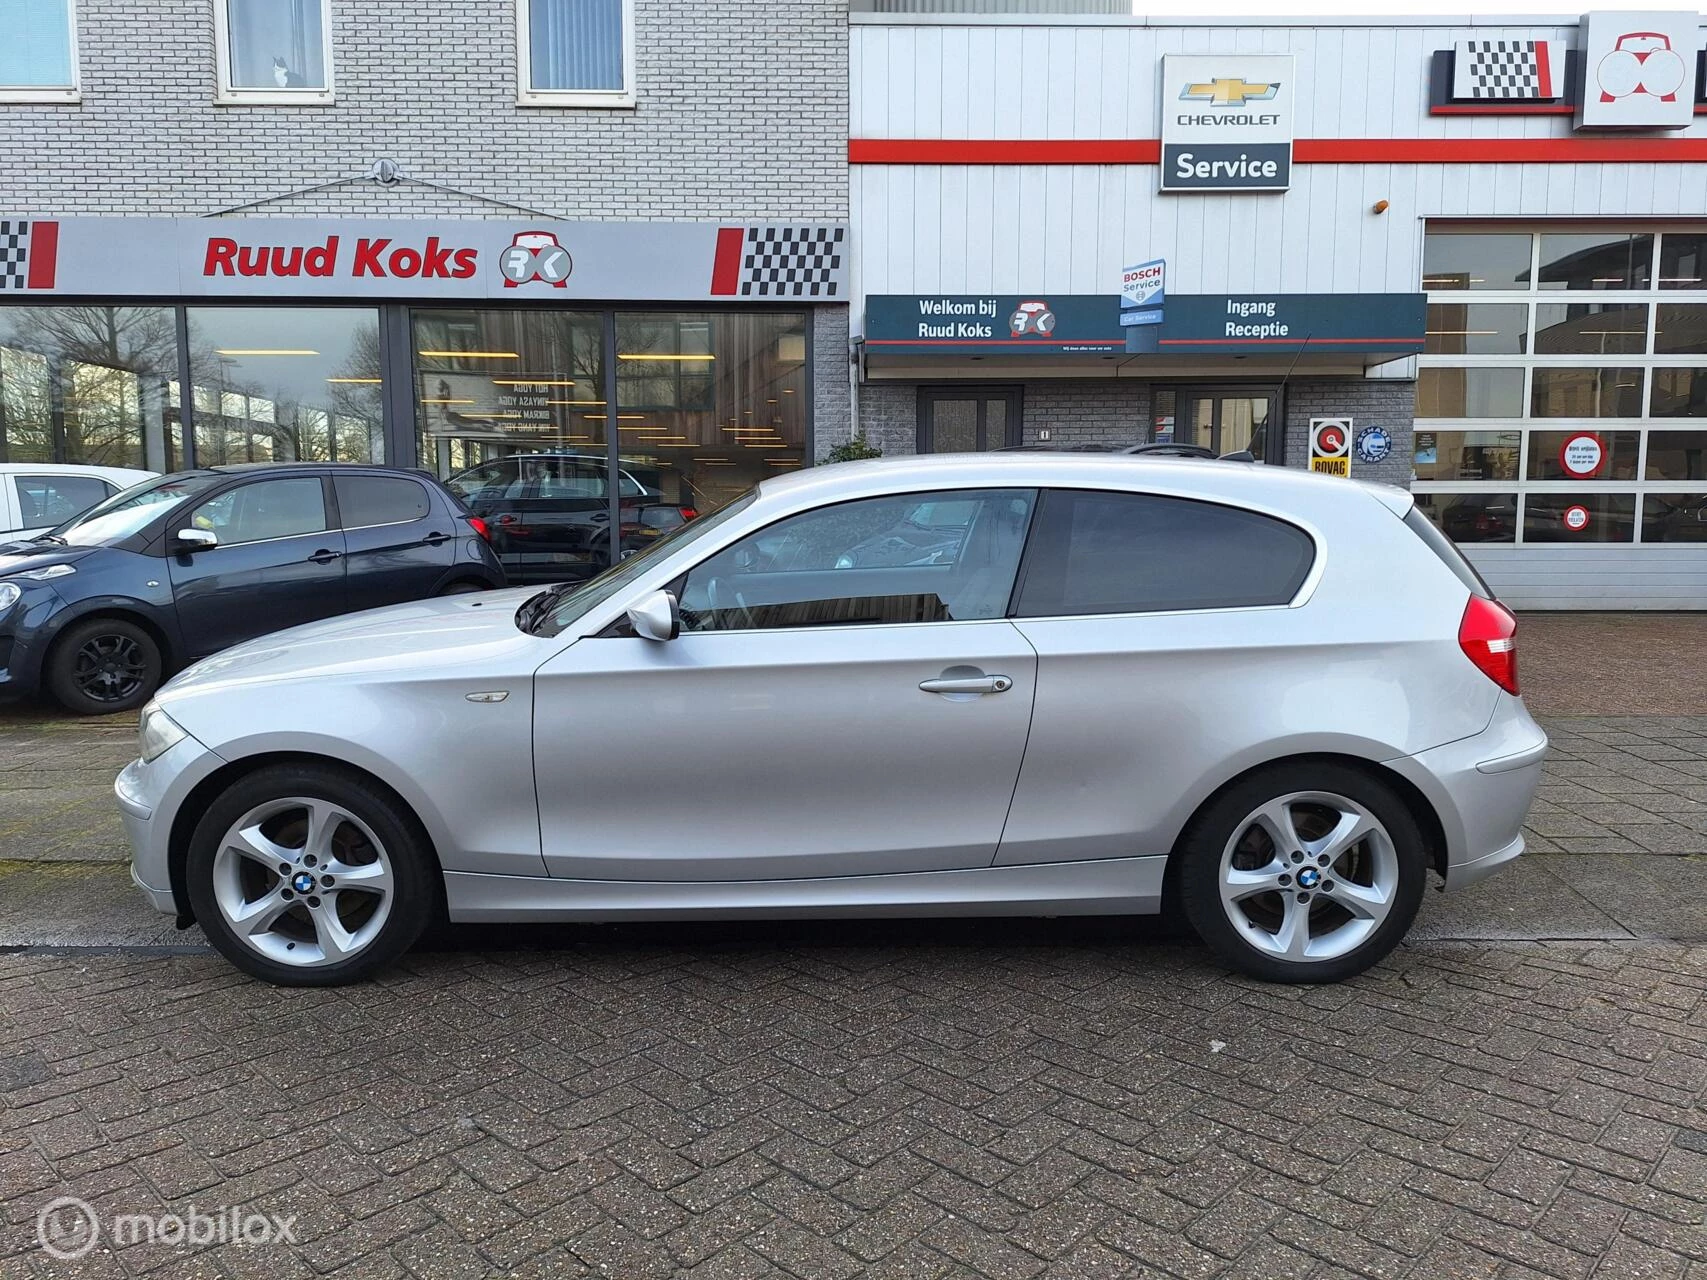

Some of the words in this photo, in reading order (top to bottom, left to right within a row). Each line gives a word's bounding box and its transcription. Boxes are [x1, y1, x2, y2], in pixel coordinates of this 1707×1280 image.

[1177, 114, 1280, 126] CHEVROLET
[1176, 153, 1278, 178] Service
[203, 235, 339, 277] Ruud
[352, 236, 479, 279] Koks
[1123, 266, 1161, 283] BOSCH
[1123, 278, 1161, 293] Service
[919, 300, 976, 315] Welkom
[979, 300, 997, 318] bij
[1227, 299, 1276, 317] Ingang
[1135, 313, 1157, 322] Service
[918, 322, 955, 338] Ruud
[957, 322, 992, 338] Koks
[1225, 321, 1289, 340] Receptie
[1357, 427, 1391, 443] SCHADE
[1357, 447, 1390, 462] GARANT
[1315, 460, 1346, 475] BOVAG
